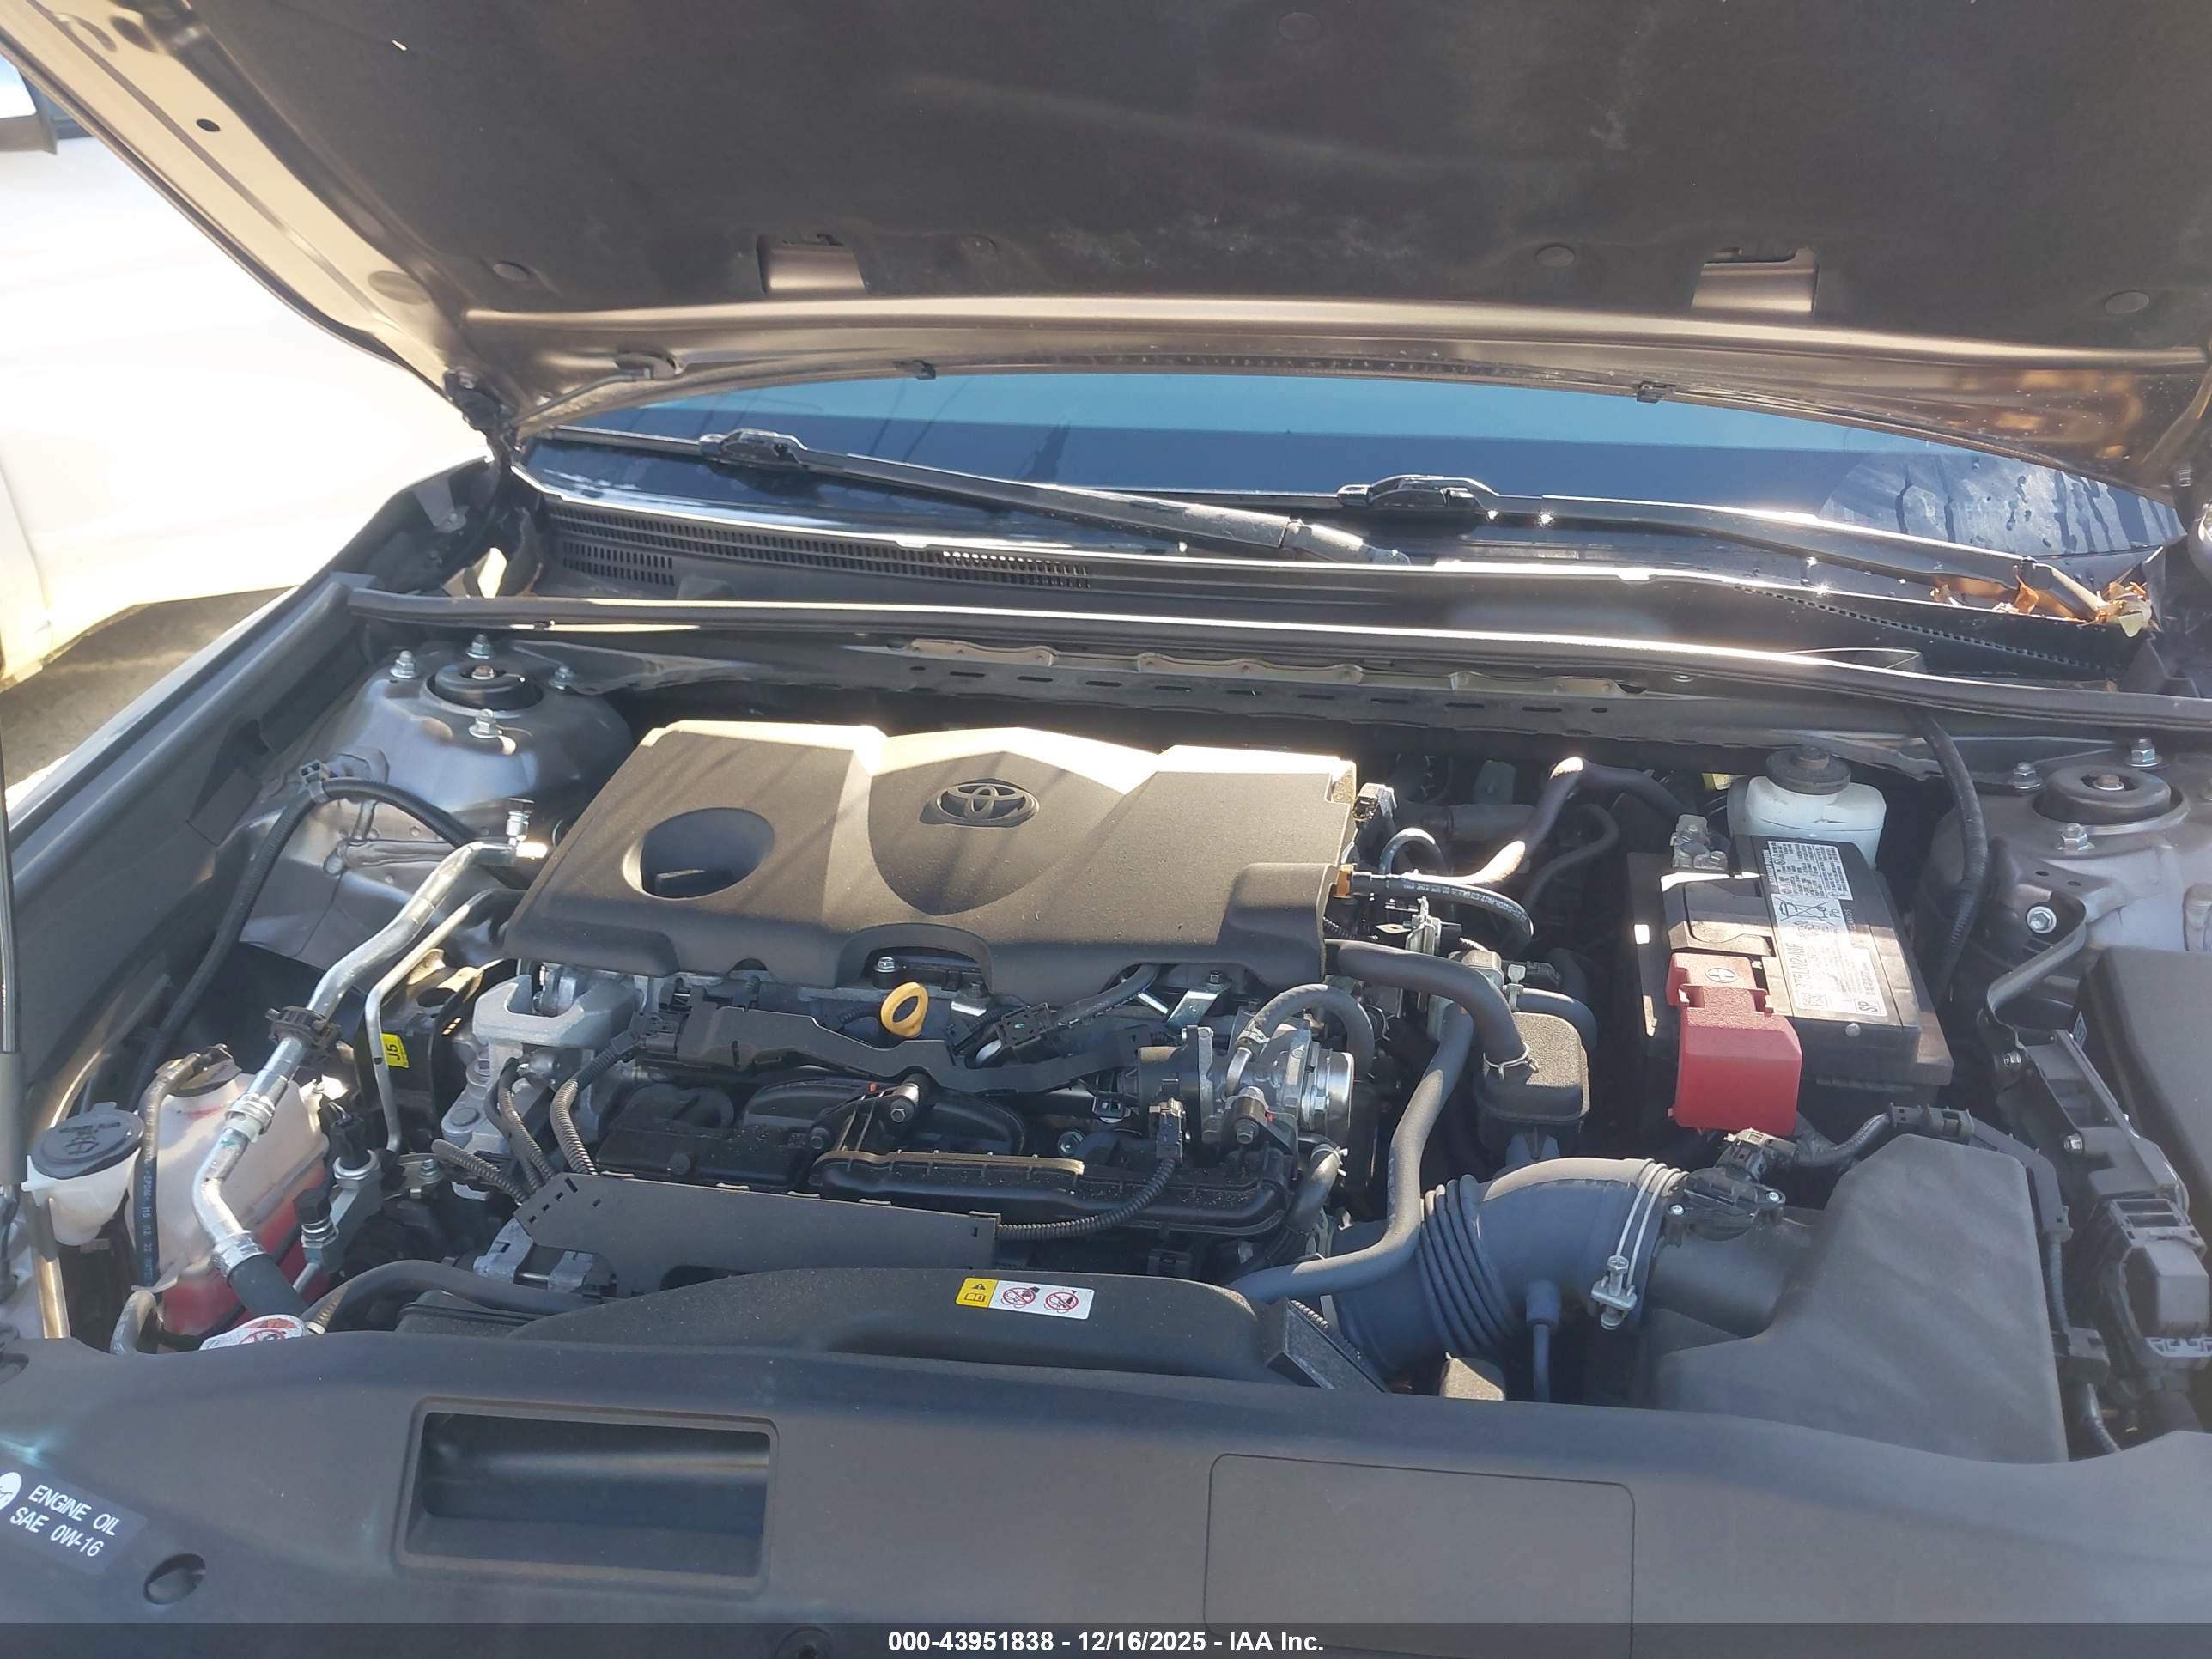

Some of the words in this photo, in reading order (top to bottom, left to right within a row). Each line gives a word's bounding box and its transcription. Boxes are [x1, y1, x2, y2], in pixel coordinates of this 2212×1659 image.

[1829, 908, 1840, 918] Pb
[1858, 1001, 1877, 1012] SP
[385, 1043, 401, 1061] J5
[27, 1485, 92, 1522] ENGINE
[93, 1513, 120, 1536] OIL
[9, 1507, 50, 1533] SAE
[50, 1524, 105, 1557] 0W-16
